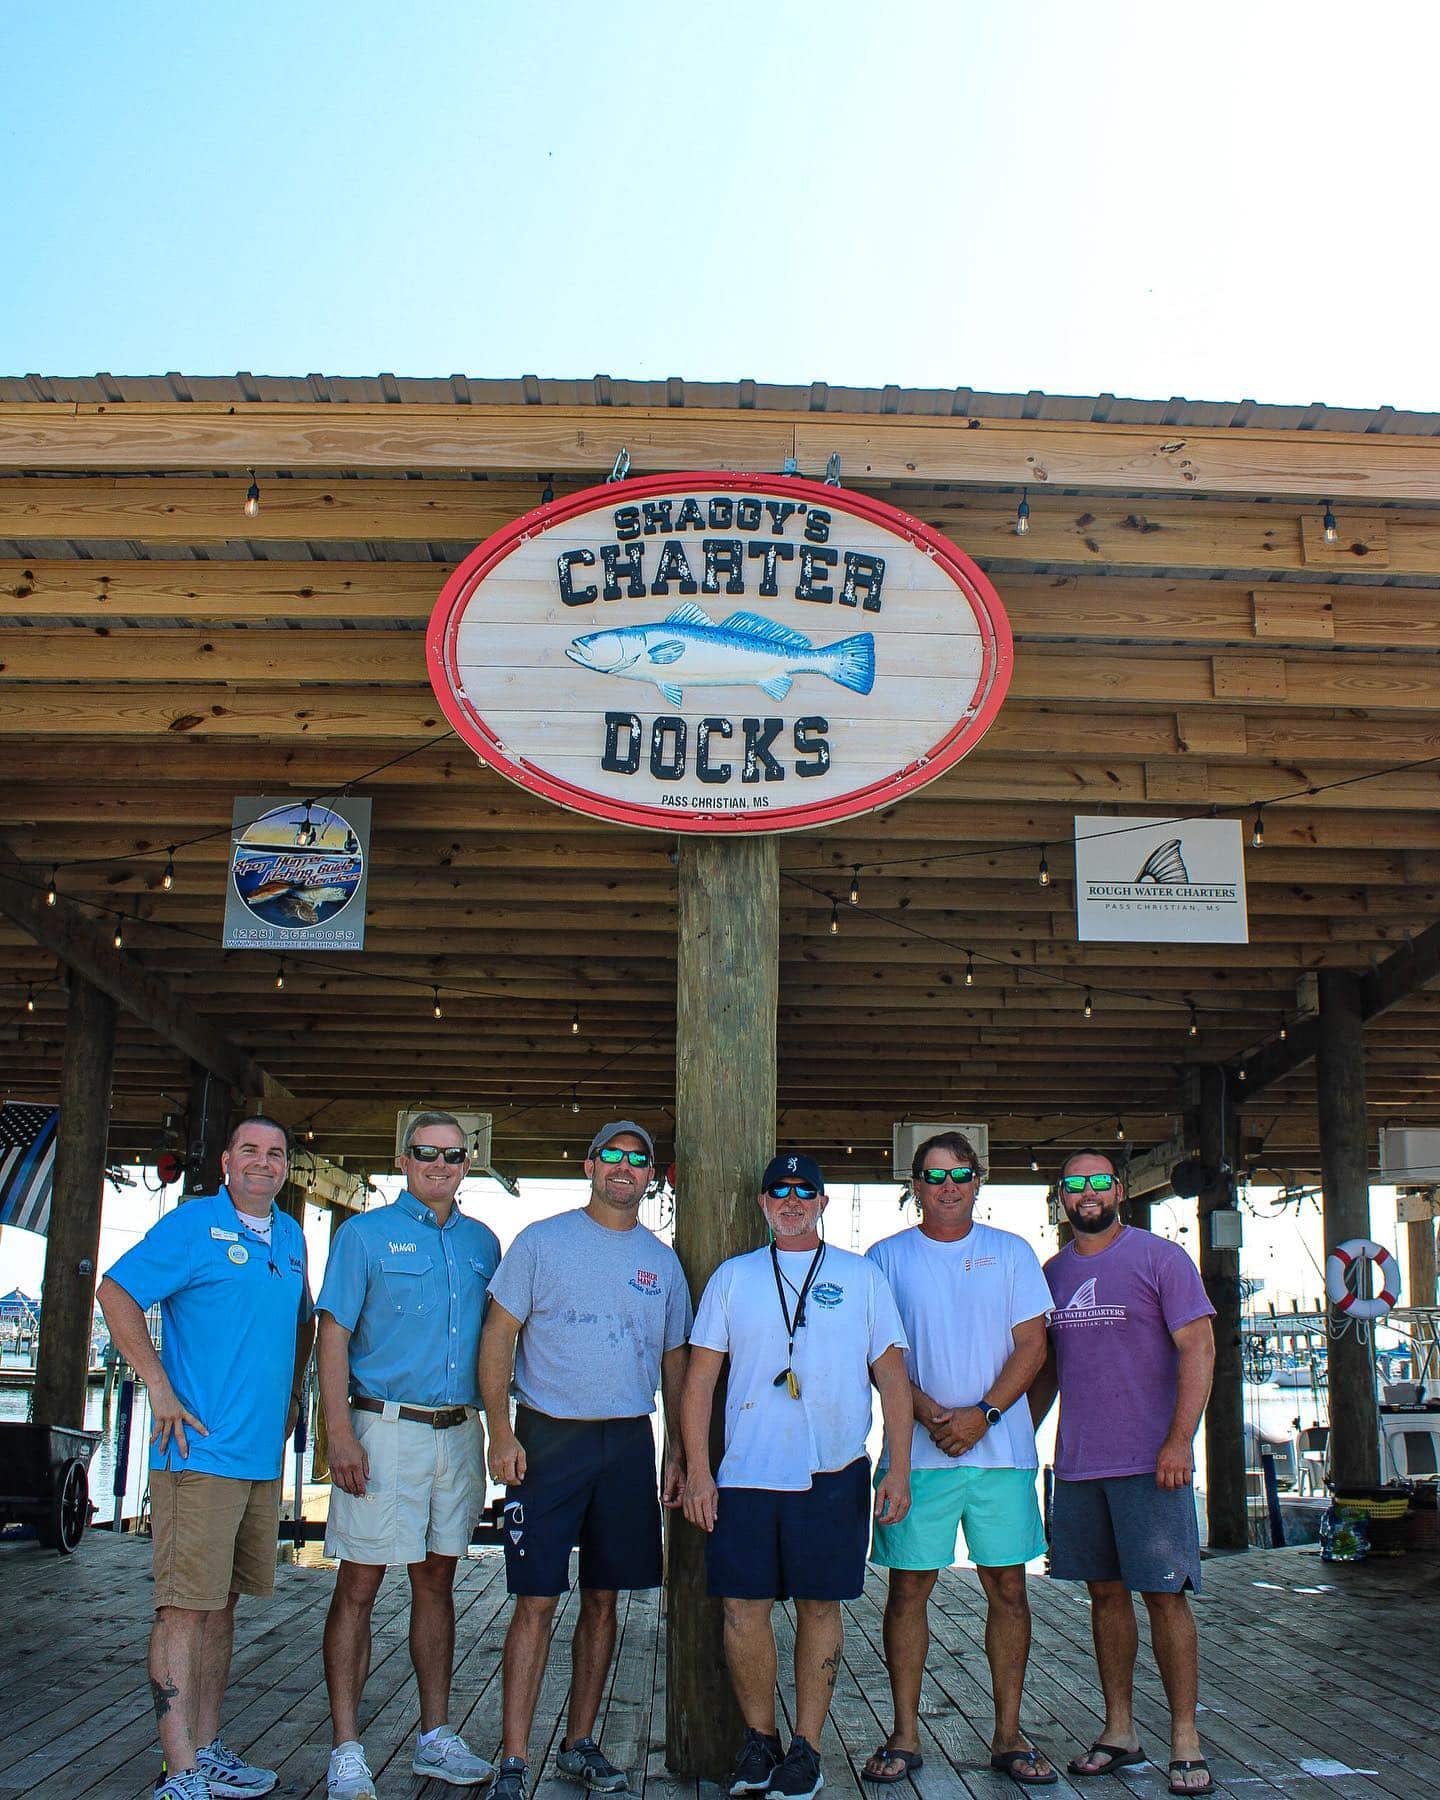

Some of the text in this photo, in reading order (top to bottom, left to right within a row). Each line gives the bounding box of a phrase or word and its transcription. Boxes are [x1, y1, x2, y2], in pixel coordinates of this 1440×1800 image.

[614, 498, 832, 543] SHAGGY'S
[557, 539, 886, 613] CHARTER
[601, 711, 830, 784] DOCKS
[661, 794, 769, 809] PASS CHRISTIAN, MS
[1089, 886, 1236, 898] ROUGH WATER CHARTERS
[1136, 904, 1201, 912] CHRISTIAN,
[232, 928, 355, 940] (228) 263-0059
[1064, 1311, 1087, 1319] WATER
[1087, 1308, 1125, 1317] CHARTERS
